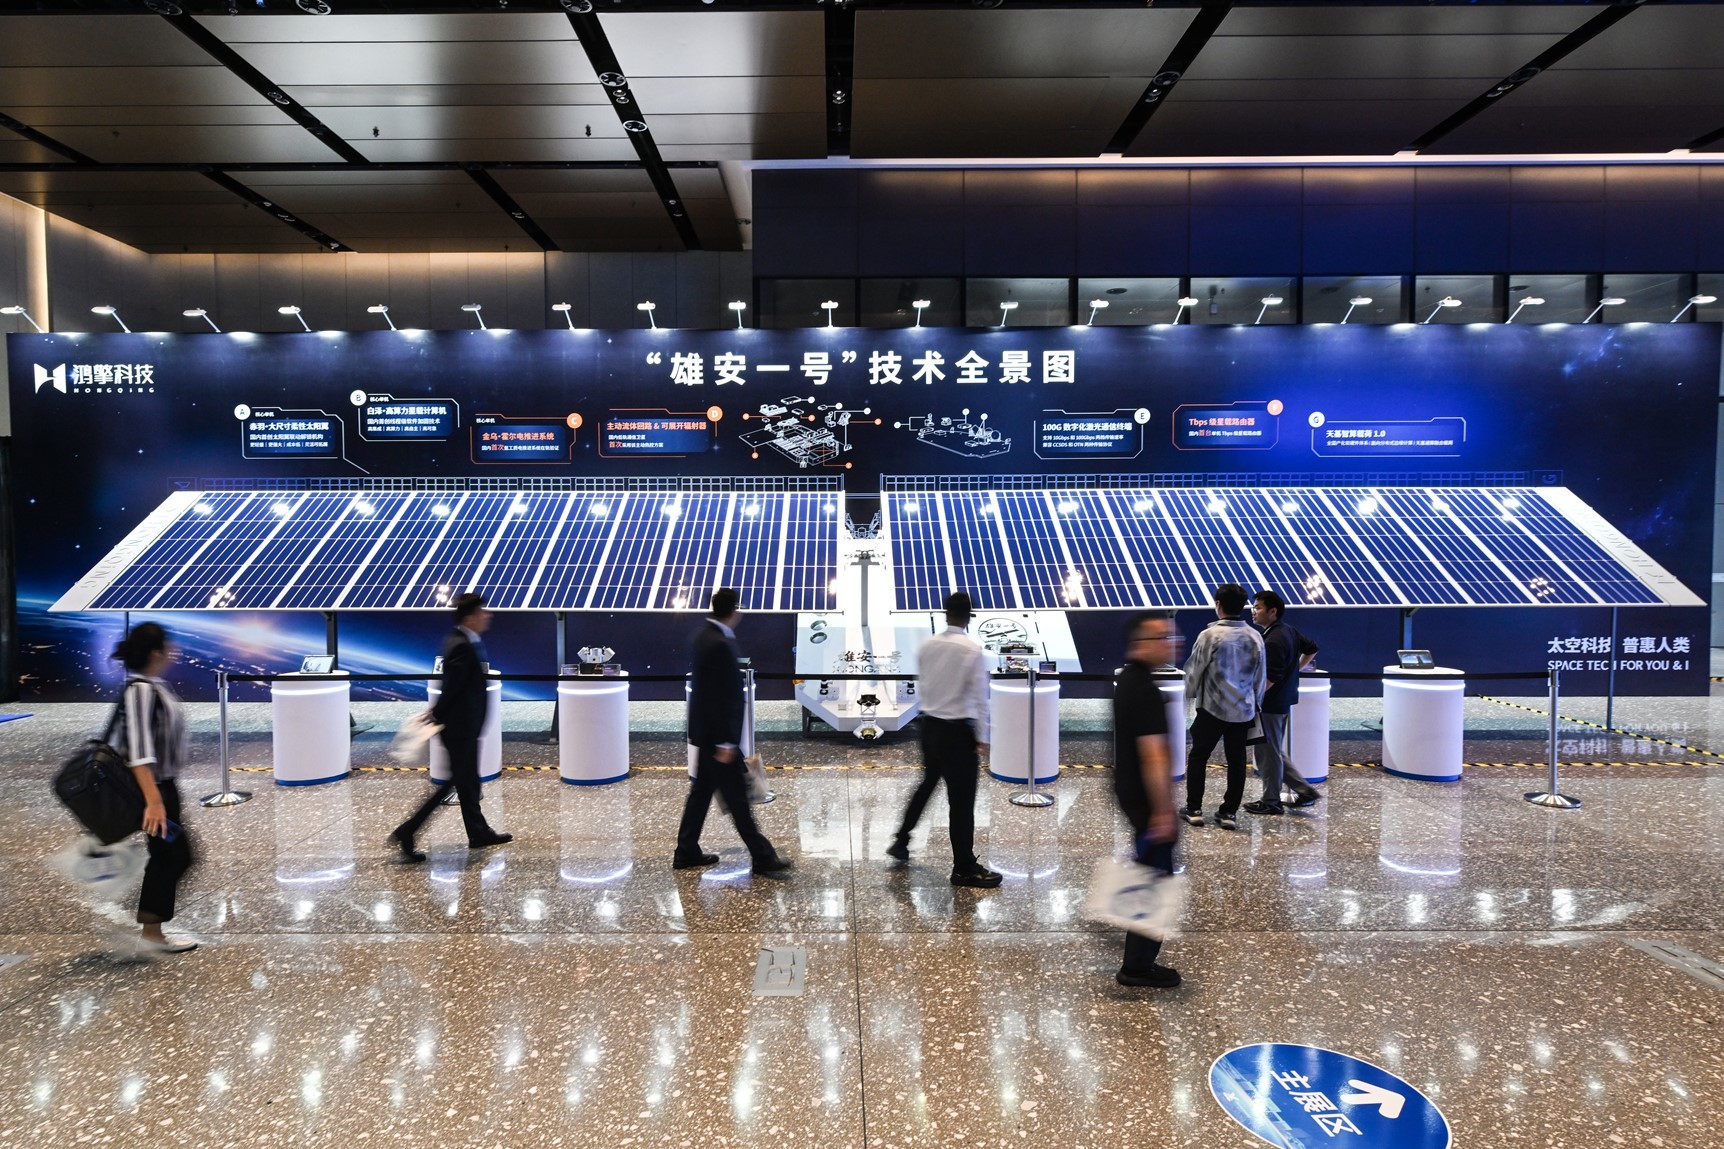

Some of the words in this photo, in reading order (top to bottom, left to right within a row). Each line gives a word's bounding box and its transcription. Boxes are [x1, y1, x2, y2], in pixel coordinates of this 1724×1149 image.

[73, 363, 155, 385] 鸿擎科技
[646, 349, 1076, 387] “雄安一号”技术全景图
[1042, 423, 1062, 431] 100G
[1188, 418, 1208, 427] Tbps
[1373, 430, 1386, 438] 1.0
[1622, 636, 1690, 654] 普惠人类
[1547, 660, 1583, 671] SPACE
[1620, 660, 1643, 671] FOR
[1646, 660, 1670, 671] YOU
[1672, 660, 1682, 671] &
[1269, 1070, 1364, 1138] 主展区
